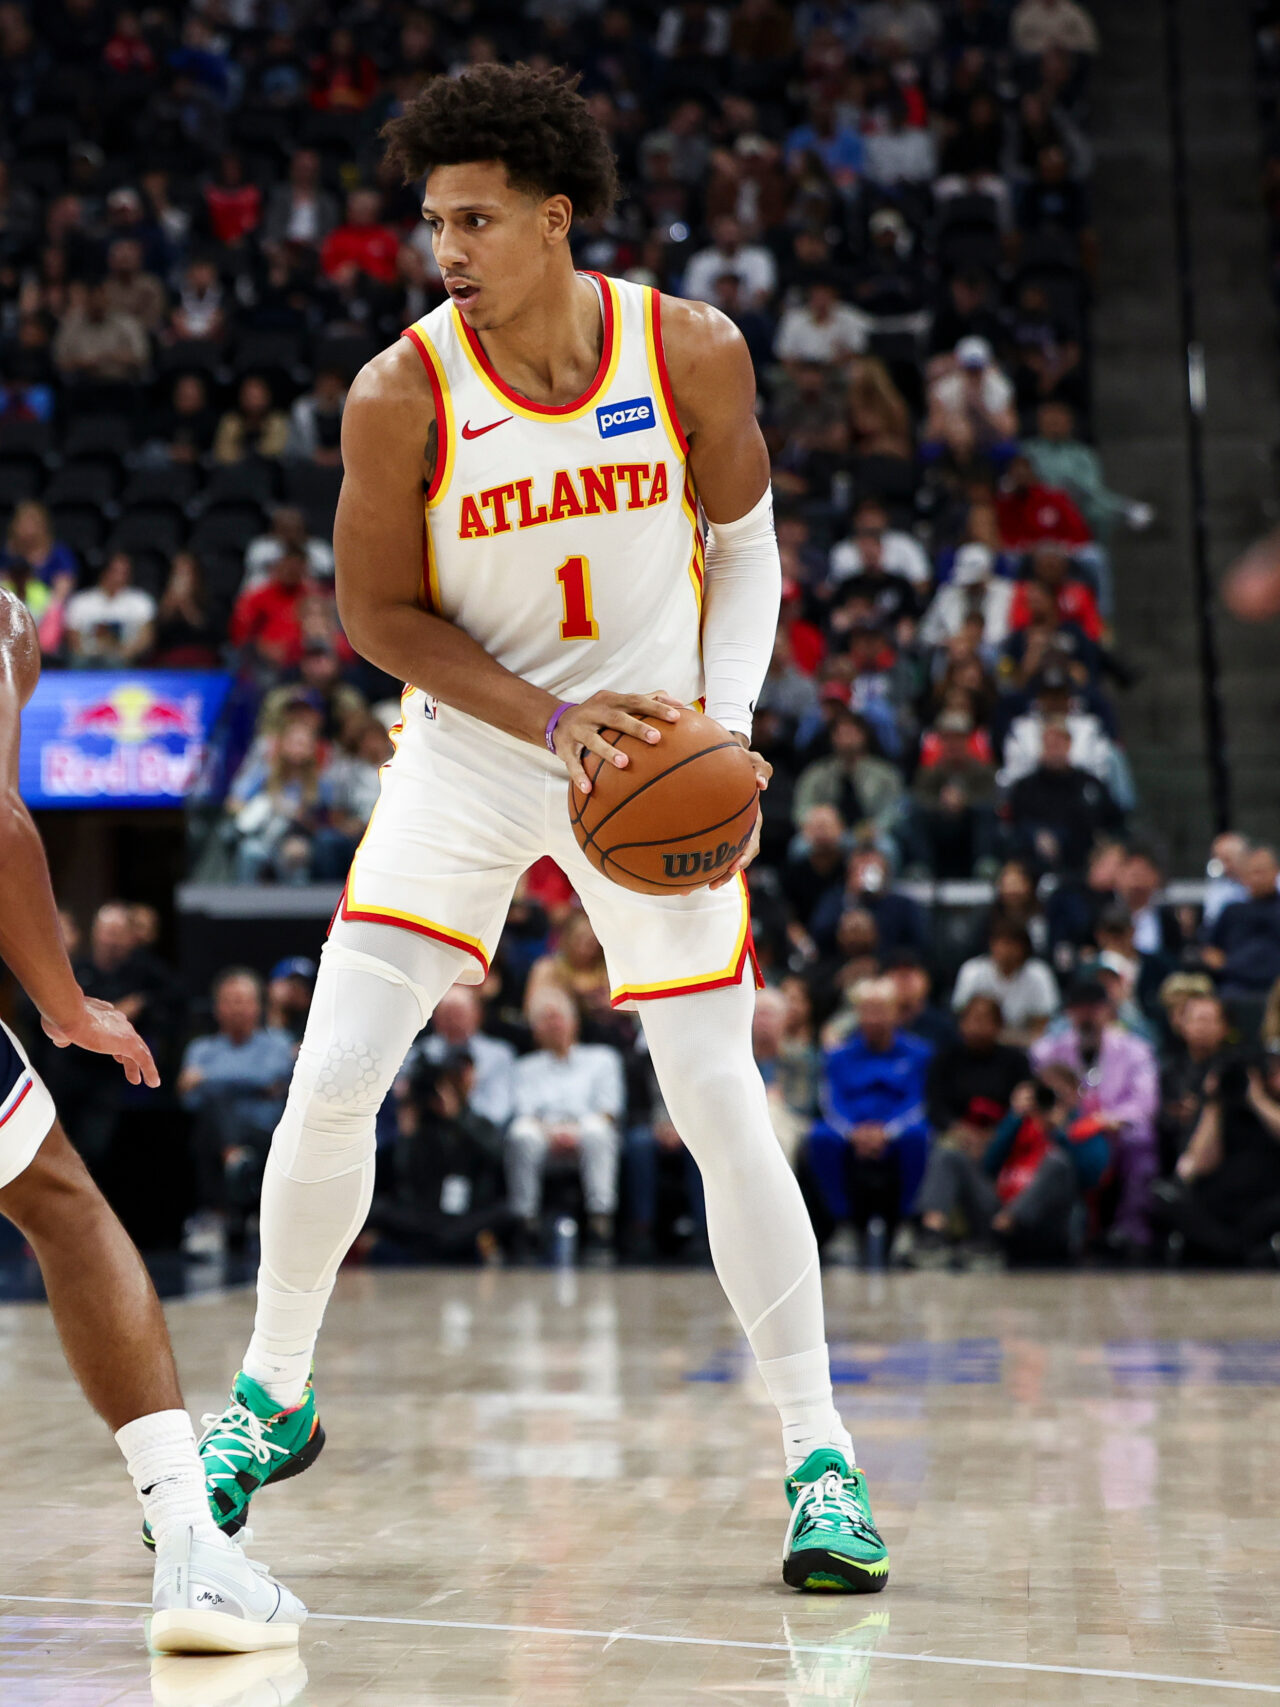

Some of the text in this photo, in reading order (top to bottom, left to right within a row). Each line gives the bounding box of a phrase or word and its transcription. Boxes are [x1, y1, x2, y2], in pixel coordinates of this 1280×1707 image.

[600, 405, 650, 431] paze
[457, 461, 669, 540] ATLANTA
[555, 555, 600, 641] 1
[41, 742, 128, 797] Red
